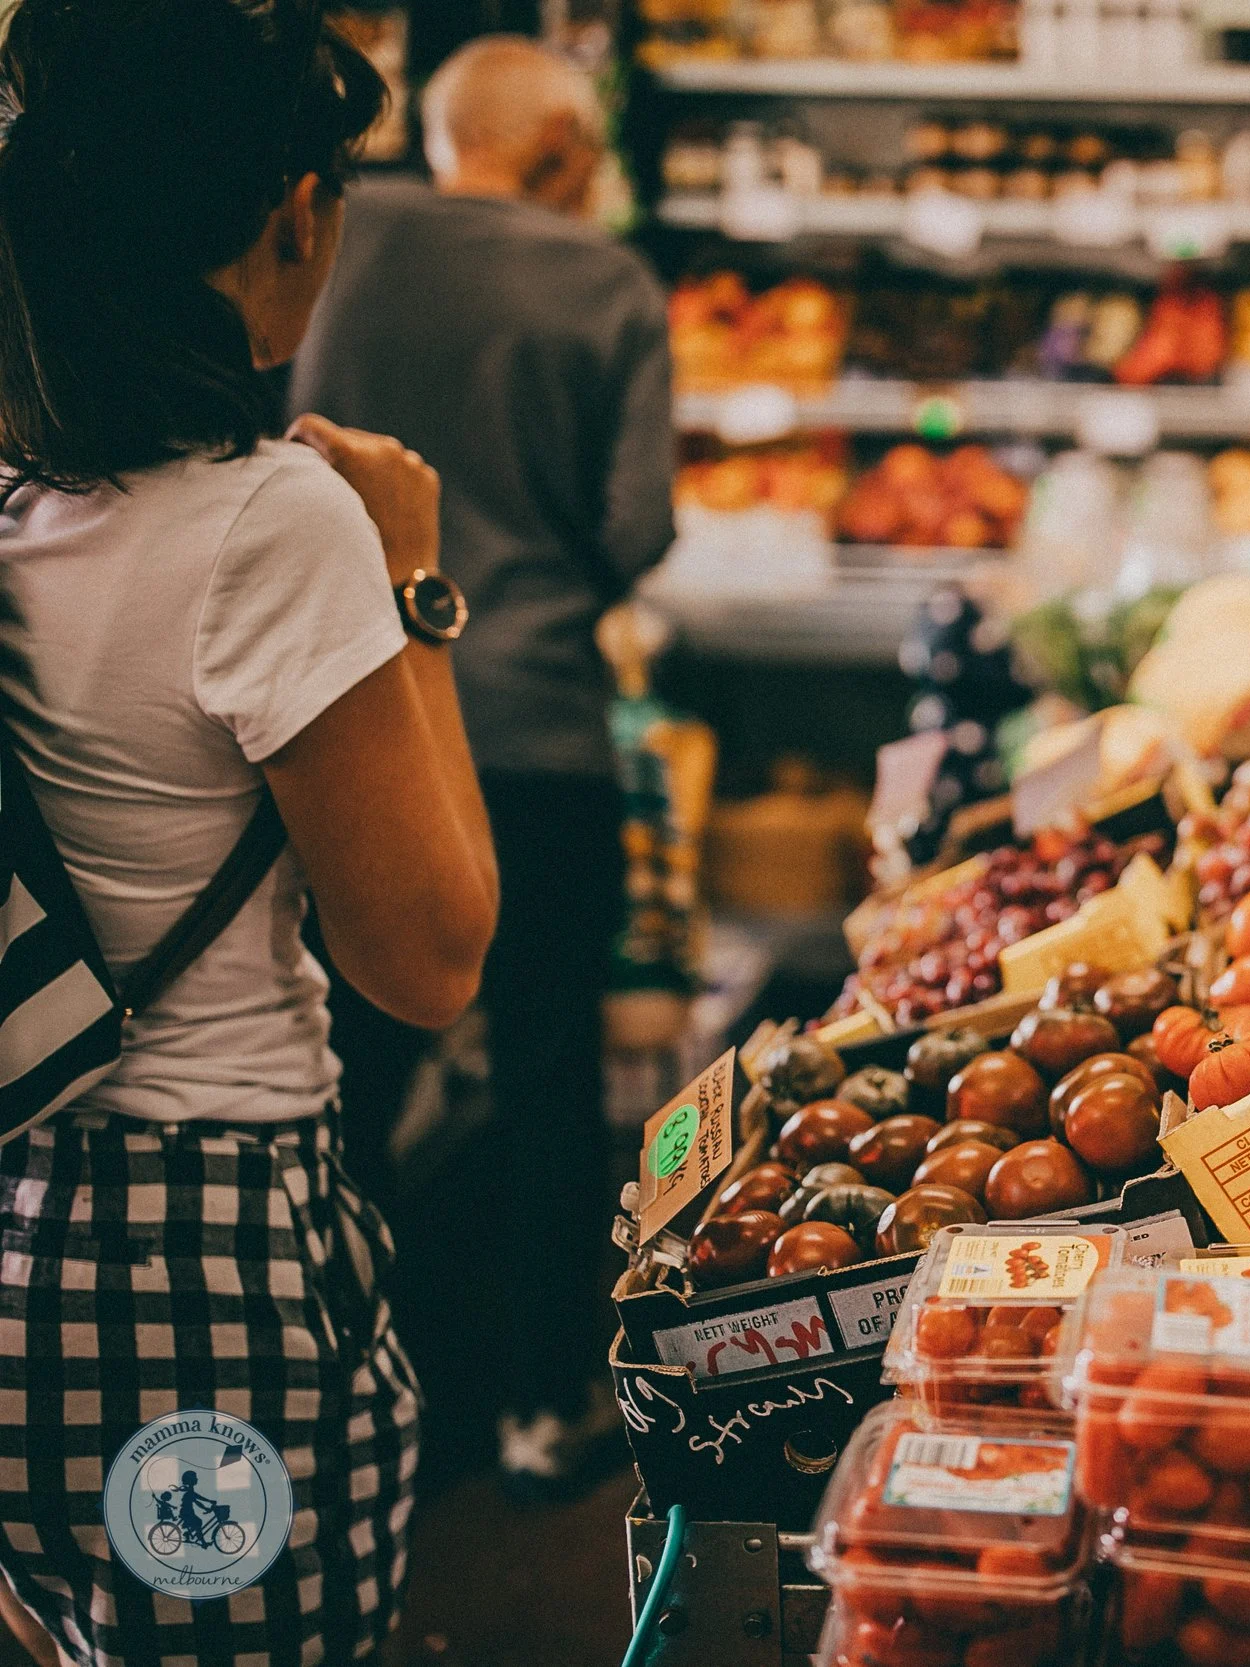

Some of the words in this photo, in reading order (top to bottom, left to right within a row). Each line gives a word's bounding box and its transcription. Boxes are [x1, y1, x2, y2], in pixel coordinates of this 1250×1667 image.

[694, 1323, 724, 1342] NETT
[728, 1311, 779, 1333] WEIGHT
[858, 1315, 881, 1335] OF
